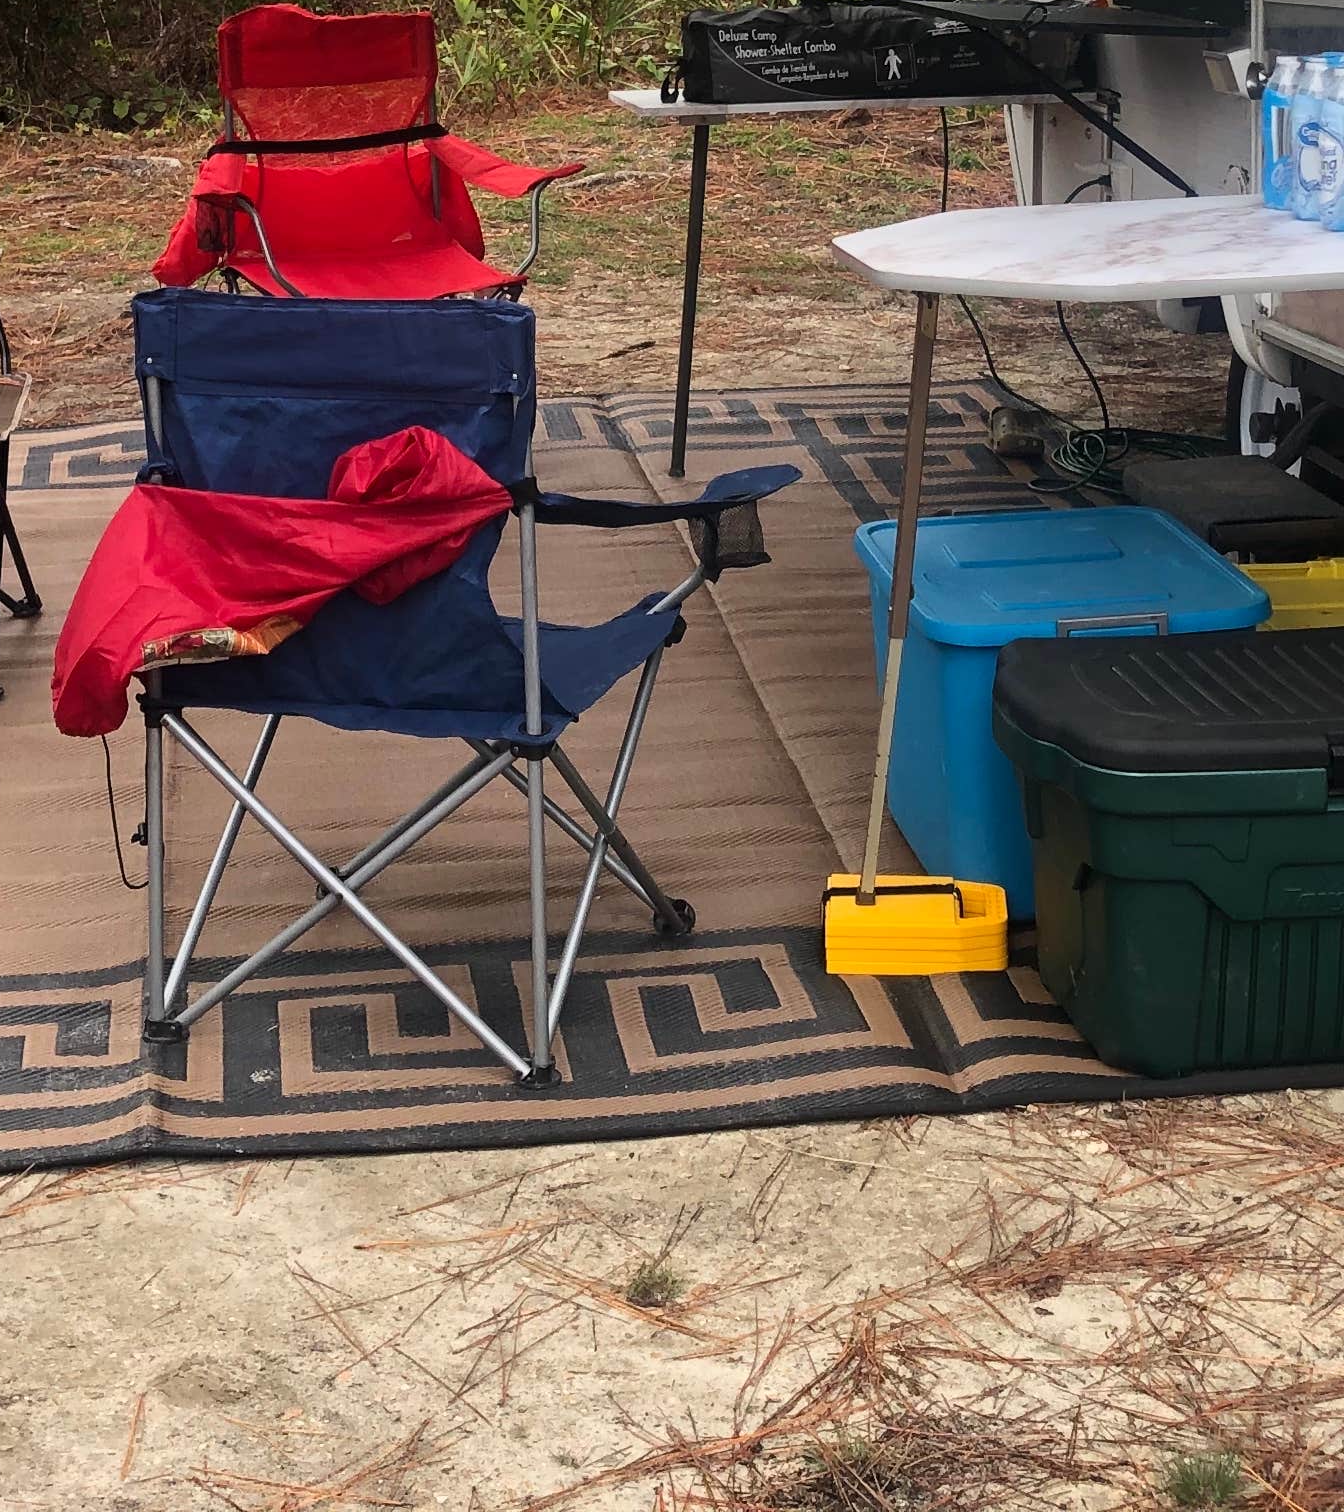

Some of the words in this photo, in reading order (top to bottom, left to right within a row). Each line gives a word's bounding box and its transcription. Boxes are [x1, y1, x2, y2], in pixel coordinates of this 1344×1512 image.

[718, 29, 749, 42] Deluxe
[752, 29, 777, 43] Camp
[735, 42, 802, 59] Shower-Shelter
[804, 40, 837, 53] Combo
